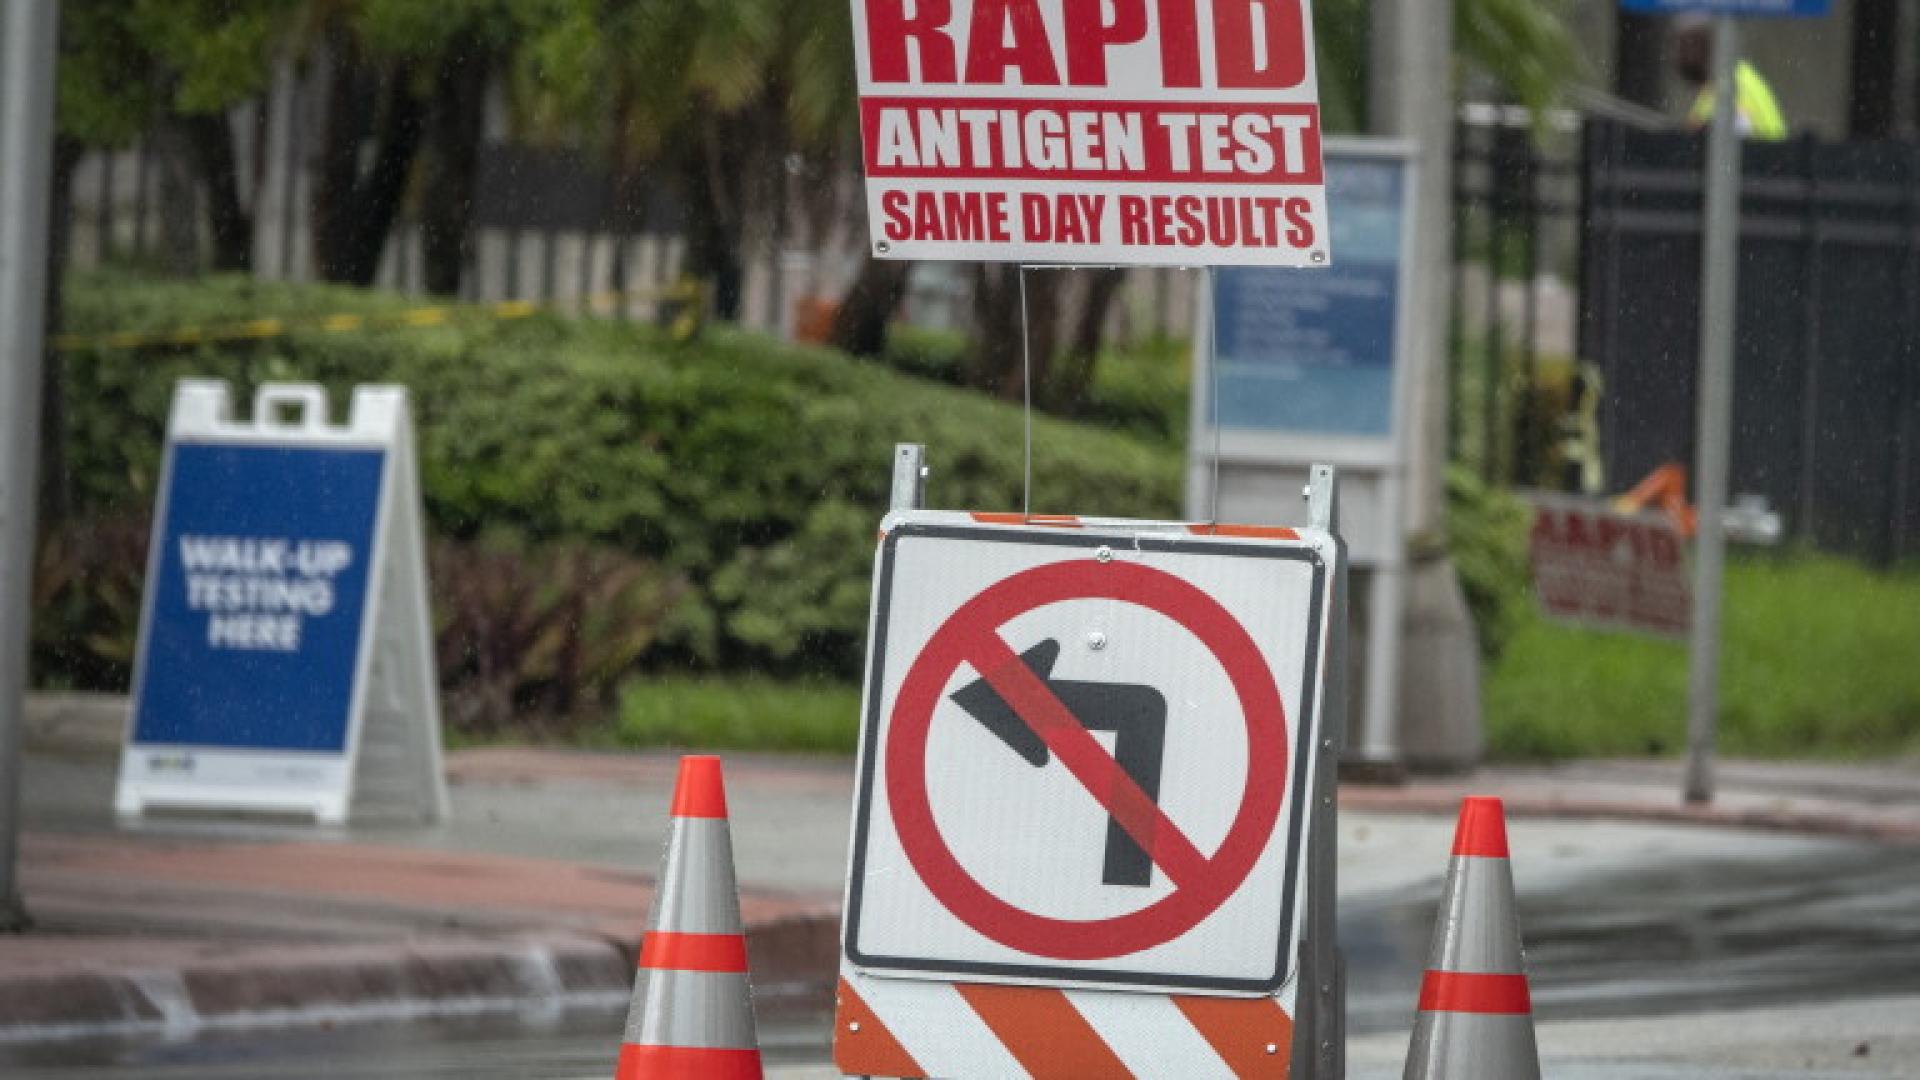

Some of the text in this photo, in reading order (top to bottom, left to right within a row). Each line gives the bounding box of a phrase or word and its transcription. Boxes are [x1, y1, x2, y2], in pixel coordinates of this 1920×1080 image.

[866, 0, 1306, 90] RAPID
[876, 107, 1311, 175] ANTIGEN TEST
[881, 189, 1316, 248] SAME DAY RESULTS
[181, 536, 351, 576] WALK-UP
[187, 574, 336, 616] TESTING
[208, 614, 299, 648] HERE
